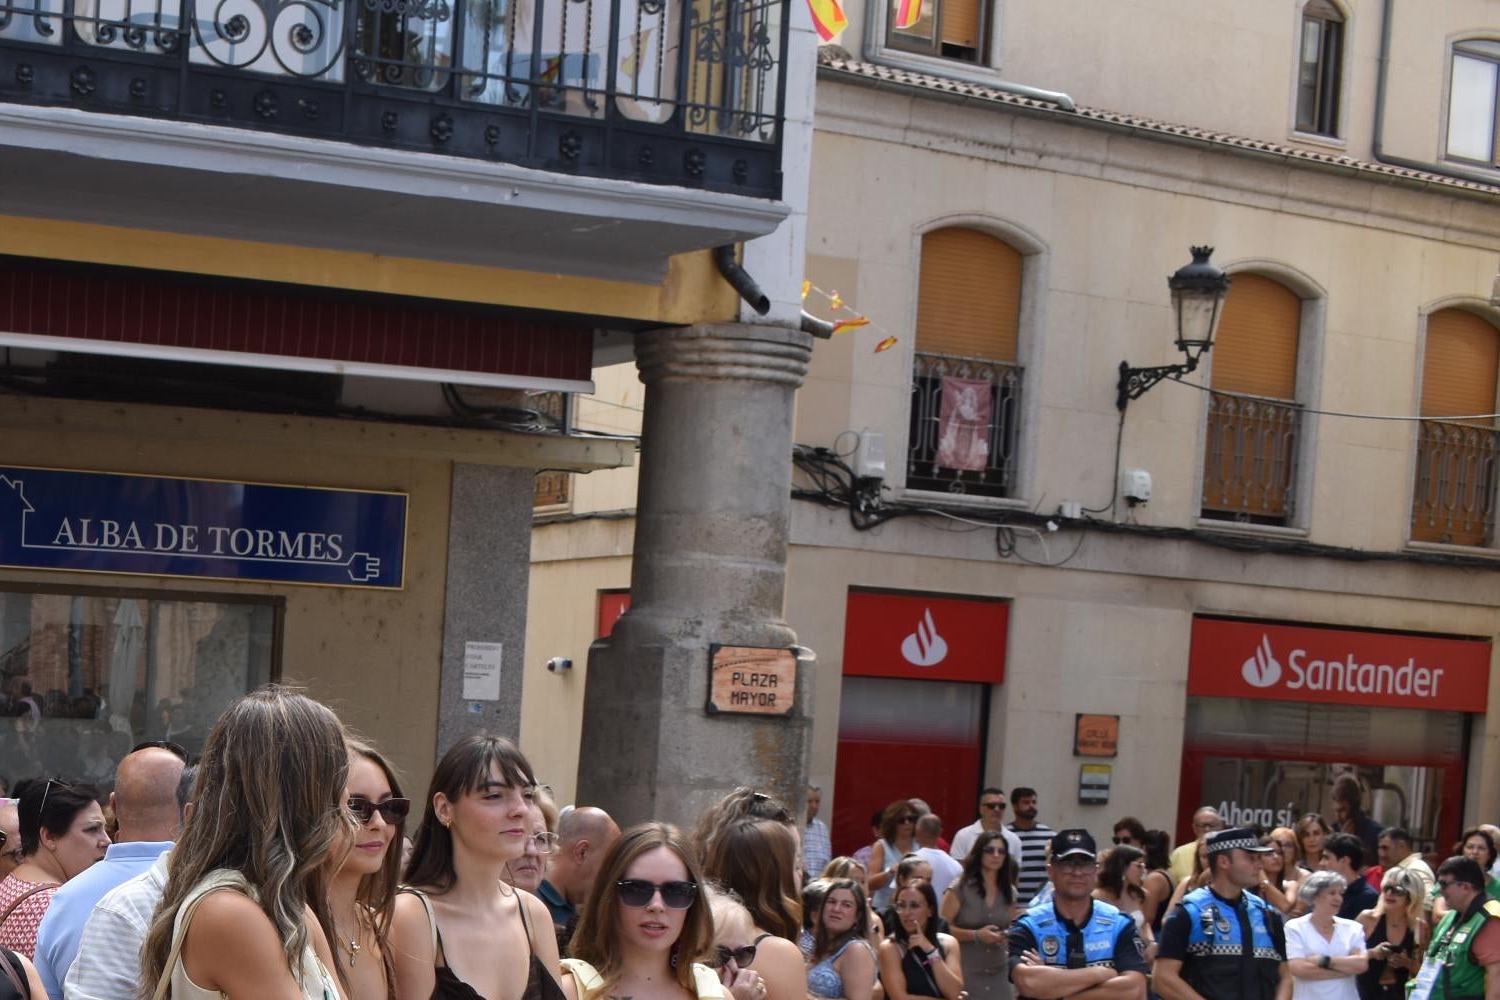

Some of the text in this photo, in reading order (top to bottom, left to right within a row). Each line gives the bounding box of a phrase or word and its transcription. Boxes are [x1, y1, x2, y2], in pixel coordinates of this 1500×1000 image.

[52, 516, 344, 562] ALBA DE TORMES
[731, 672, 778, 688] PLAZA
[1286, 648, 1445, 698] Santander
[730, 691, 777, 707] MAYOR
[1219, 801, 1274, 828] Ahora
